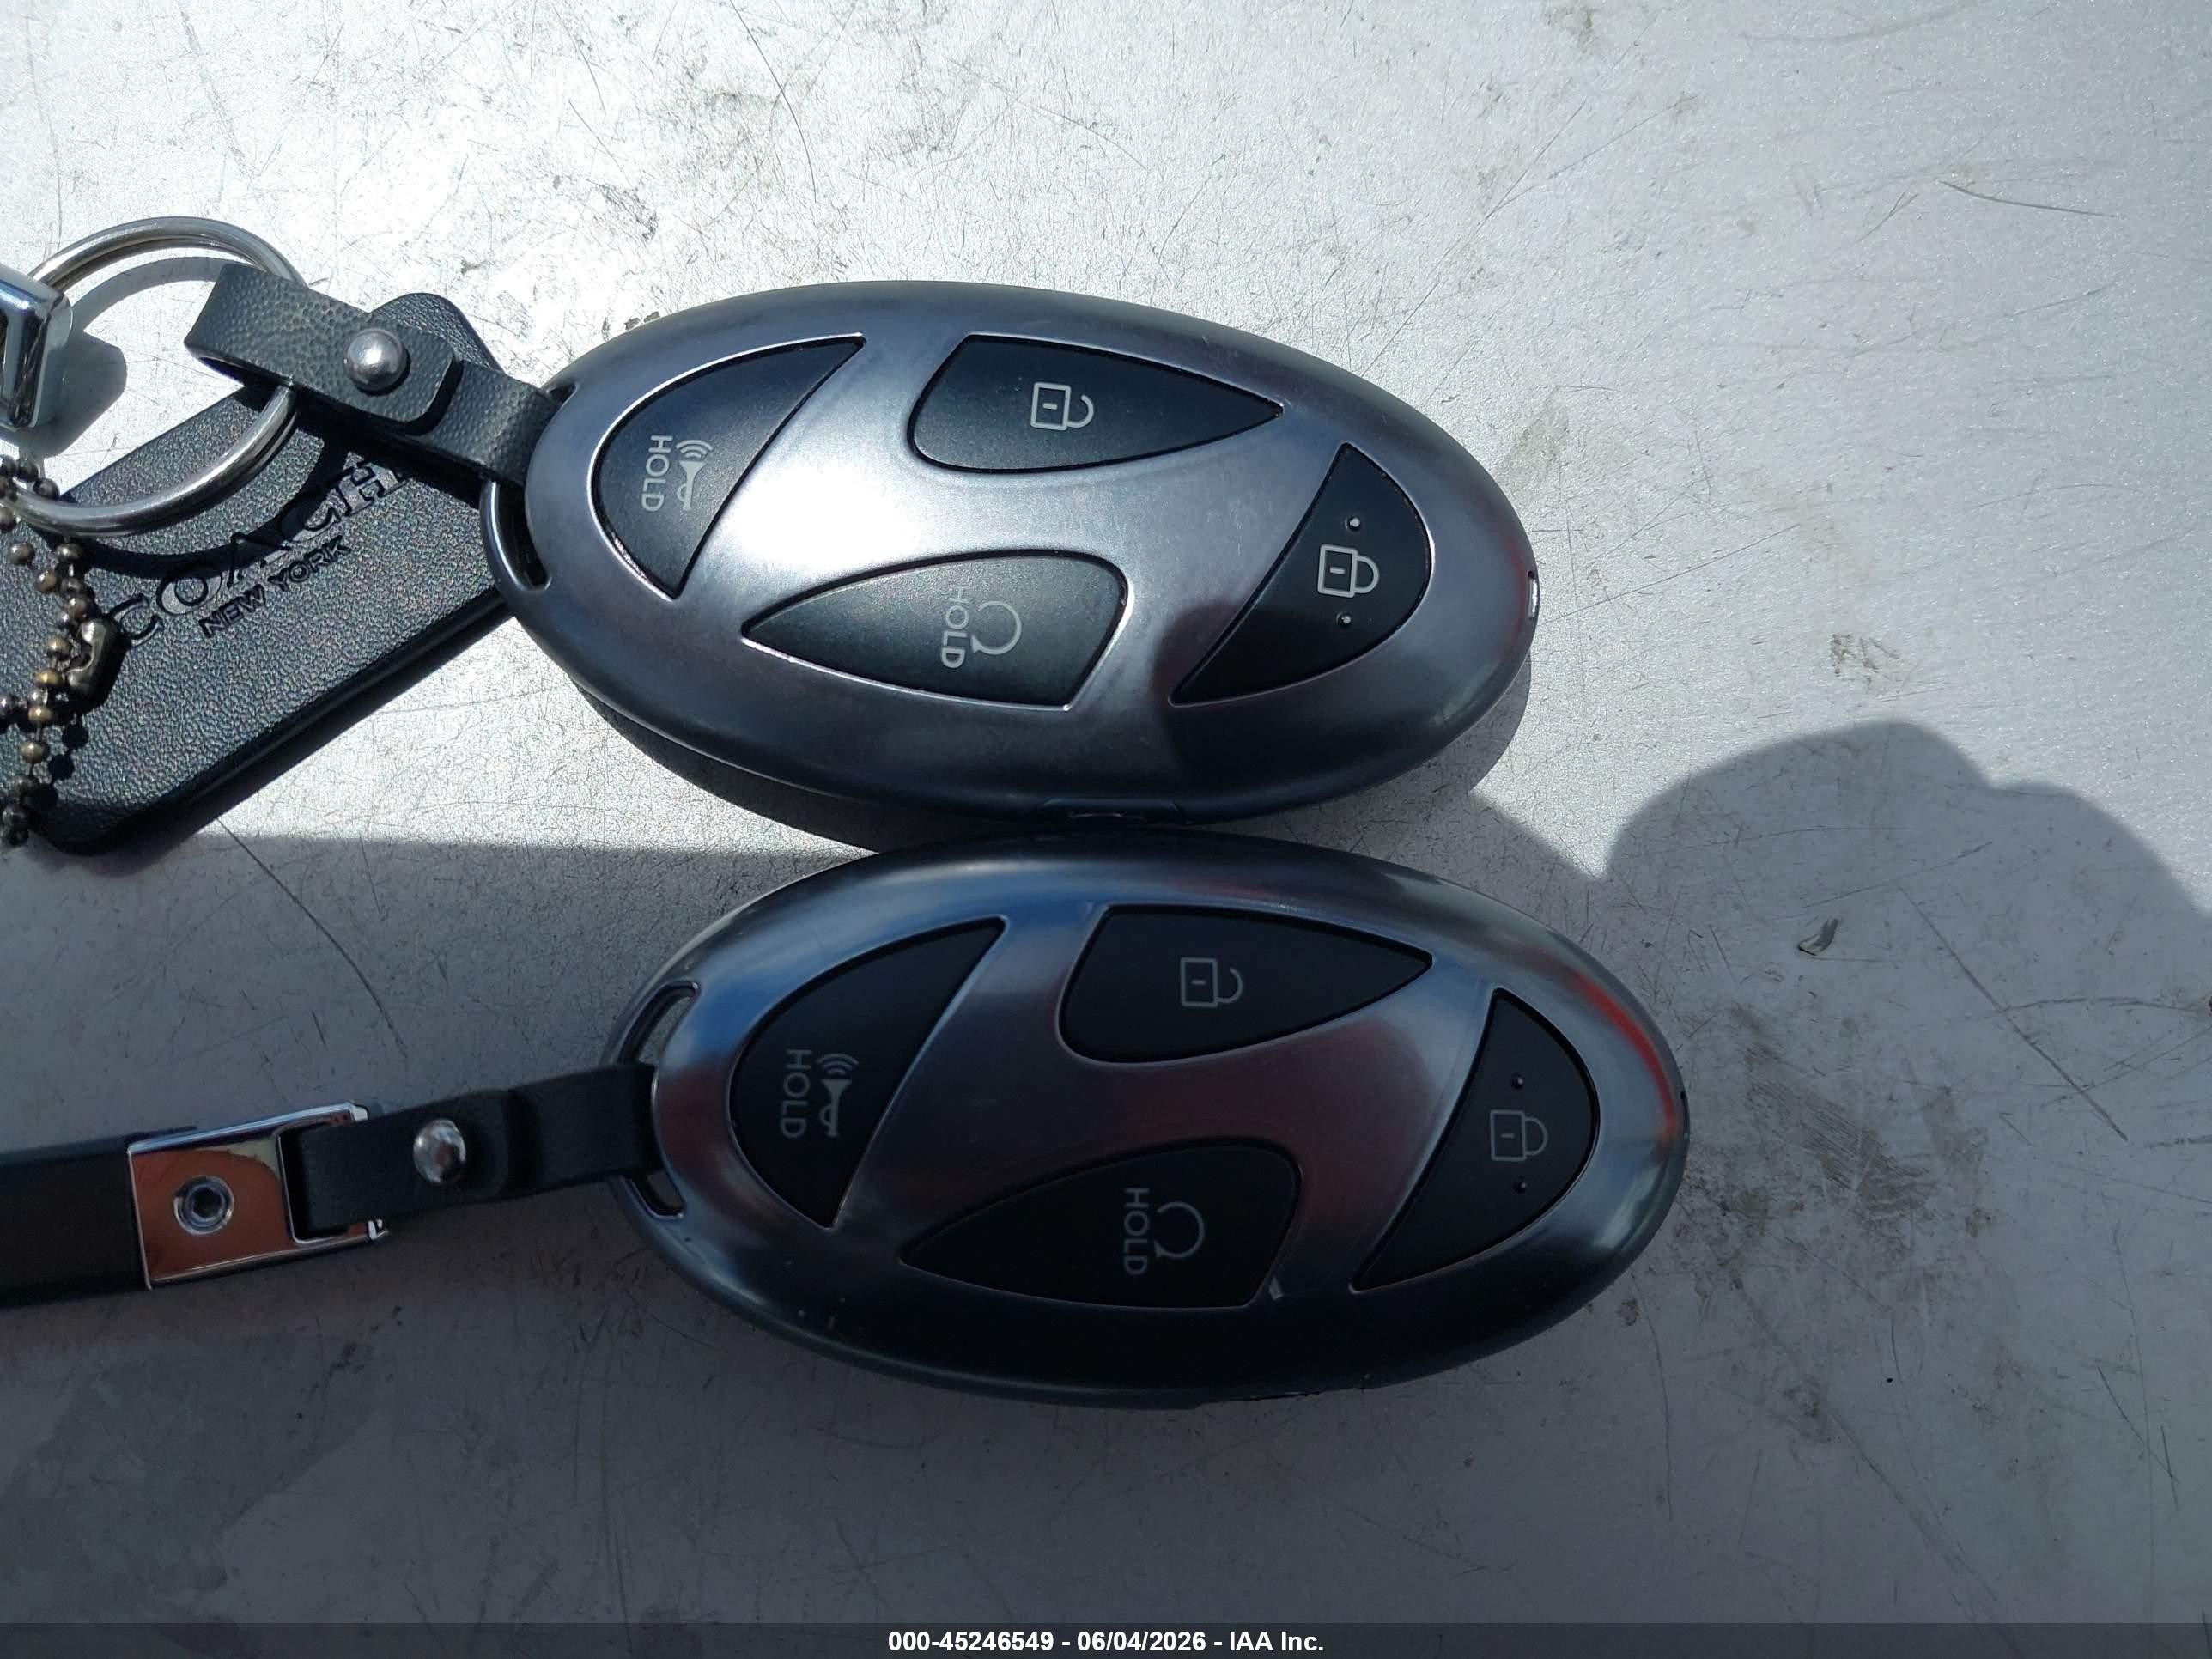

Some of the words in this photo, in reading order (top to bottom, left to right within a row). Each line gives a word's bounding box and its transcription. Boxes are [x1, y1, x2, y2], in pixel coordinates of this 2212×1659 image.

[641, 434, 673, 513] HOLD
[107, 451, 407, 645] COACH
[198, 583, 266, 638] NEW
[267, 534, 352, 592] YORK
[939, 585, 972, 669] HOLD
[780, 1048, 813, 1139] HOLD
[1123, 1188, 1151, 1276] HOLD
